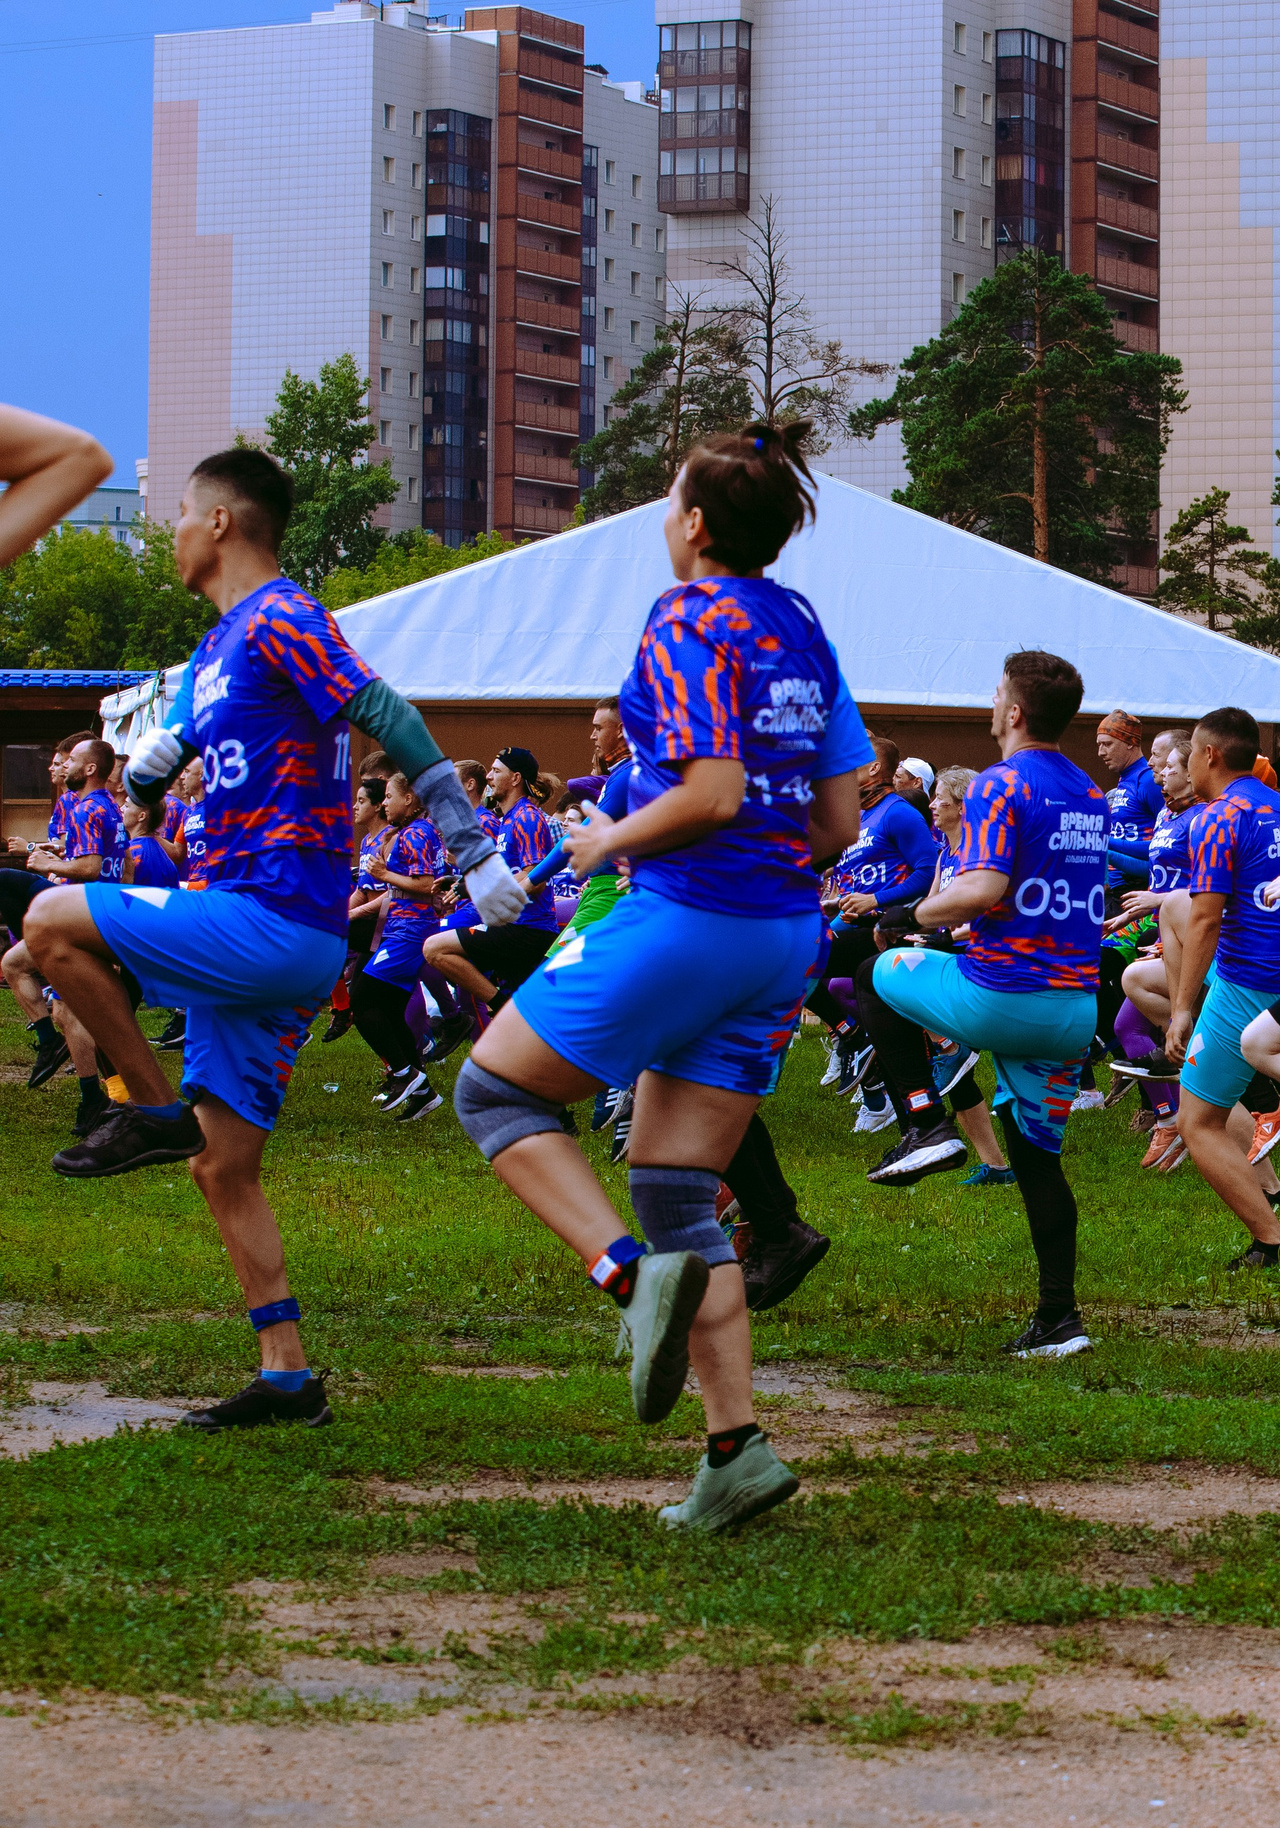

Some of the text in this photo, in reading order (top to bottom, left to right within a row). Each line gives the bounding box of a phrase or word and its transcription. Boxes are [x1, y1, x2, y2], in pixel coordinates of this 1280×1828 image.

[1060, 812, 1104, 831] ВРЕМЯ
[1048, 831, 1109, 852] СИЛЬНЫ
[1015, 877, 1105, 925] 03-0
